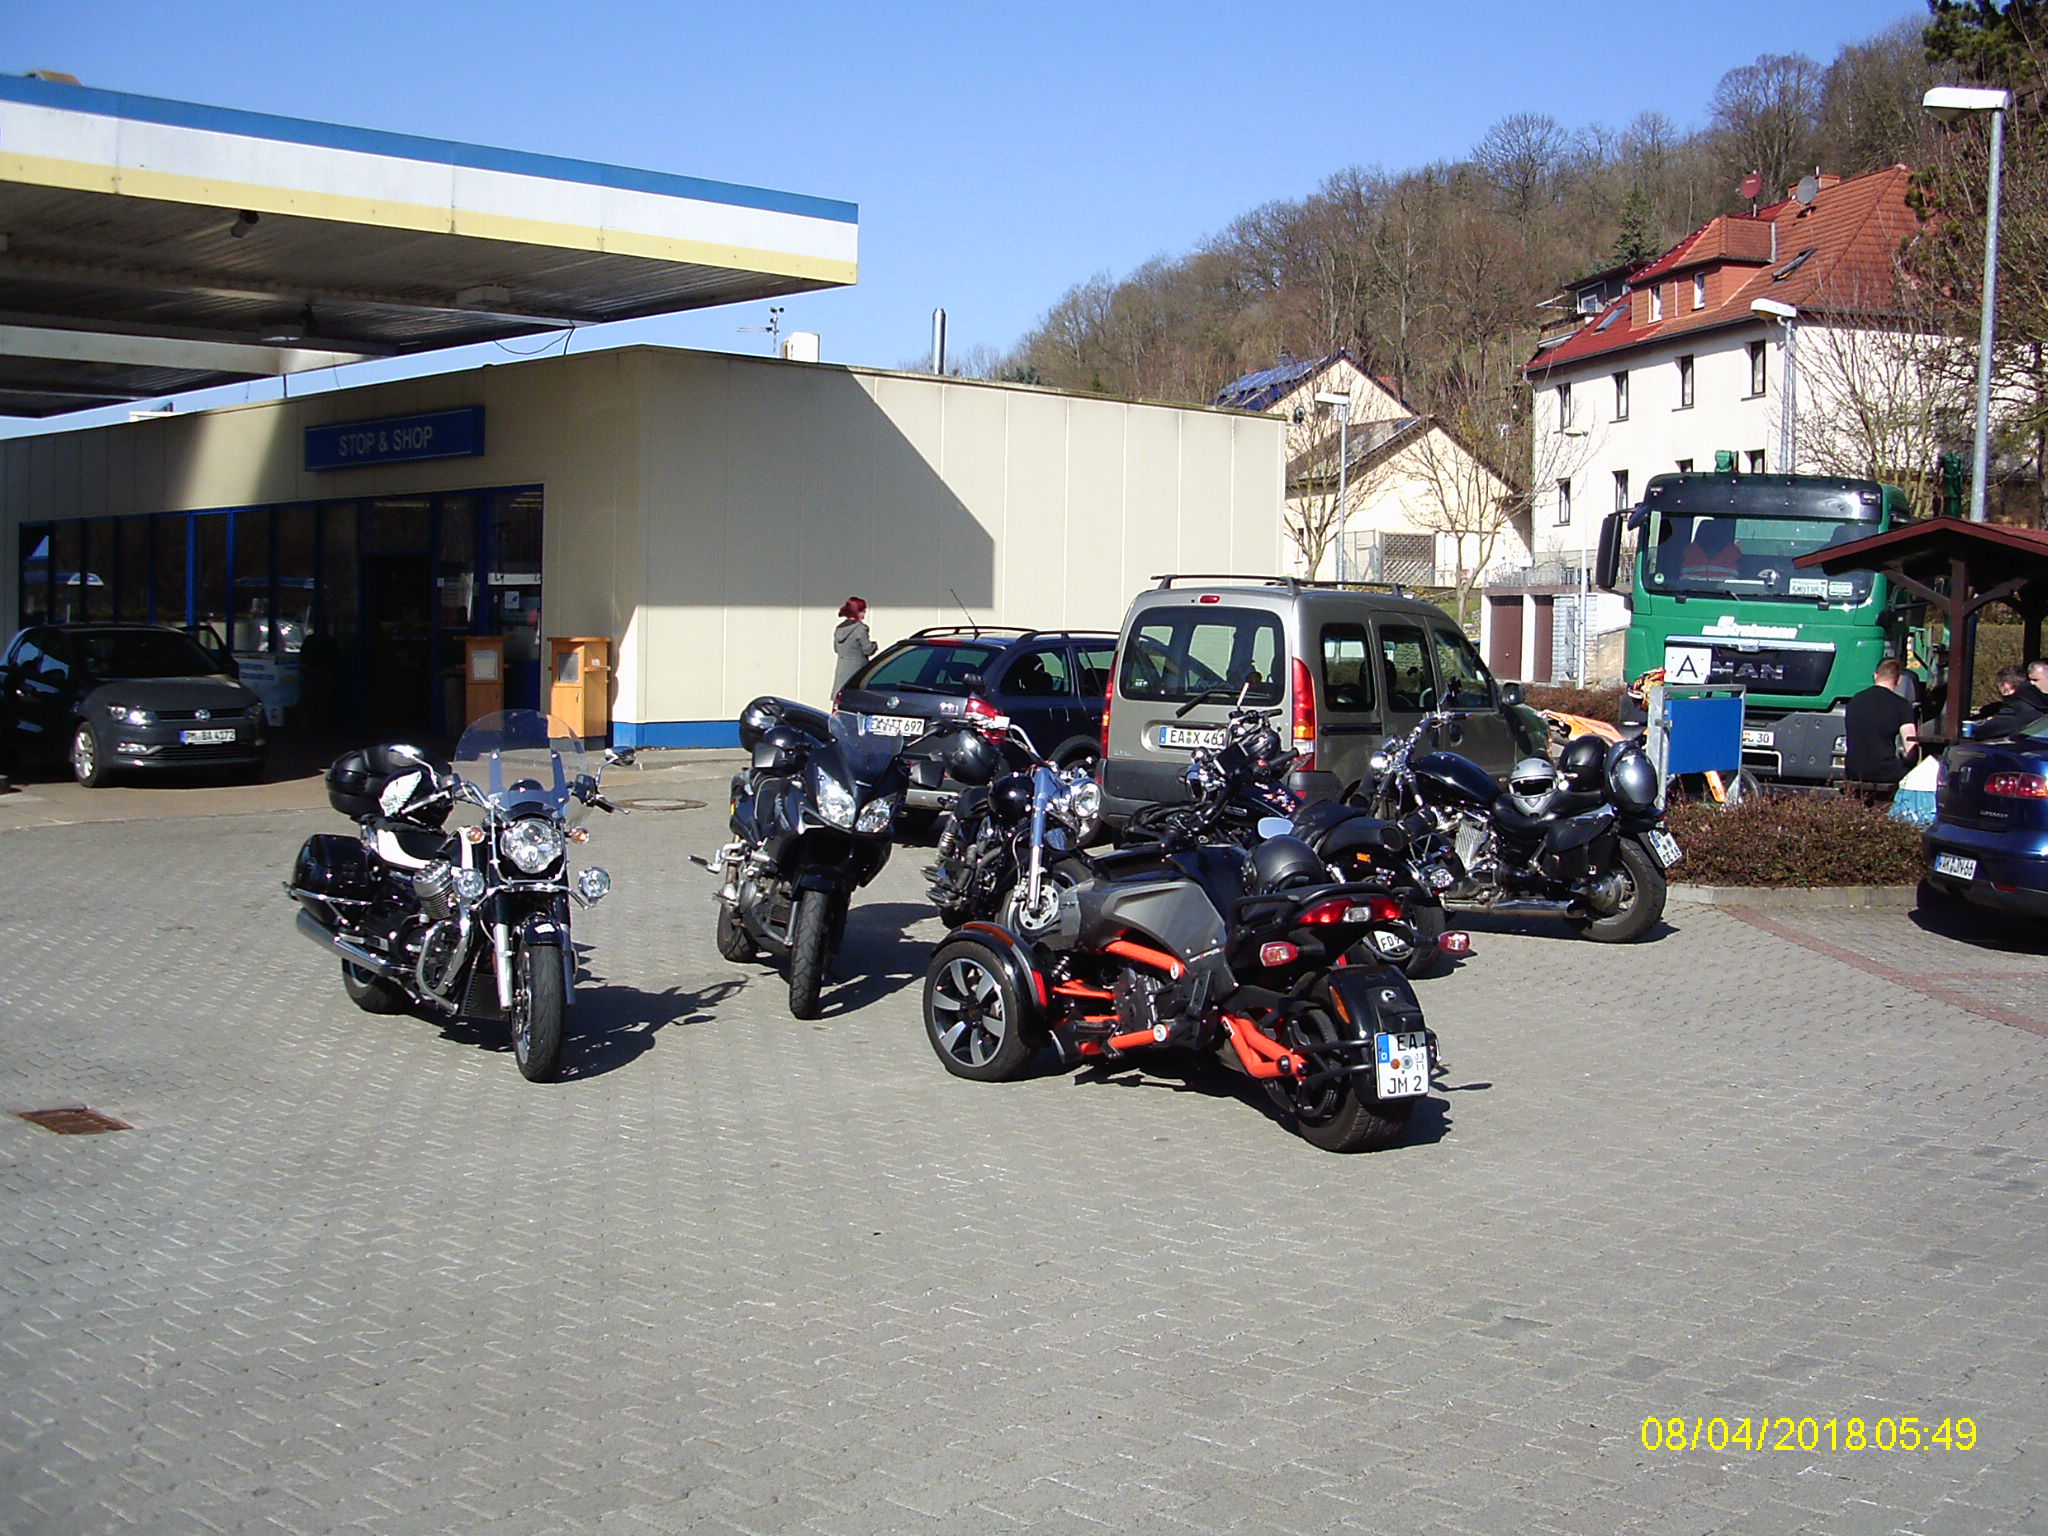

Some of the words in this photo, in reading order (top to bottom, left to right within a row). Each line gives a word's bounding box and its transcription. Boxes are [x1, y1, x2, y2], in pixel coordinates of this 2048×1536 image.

[339, 431, 375, 456] STOP
[378, 431, 388, 452] &
[393, 425, 432, 450] SHOP
[1676, 654, 1698, 678] A
[1711, 660, 1784, 680] MAN
[904, 720, 923, 733] 697
[1170, 730, 1184, 743] EA
[1193, 732, 1201, 745] X
[1756, 733, 1770, 744] 30
[1397, 1033, 1418, 1051] EA
[1387, 1077, 1409, 1095] JM
[1413, 1075, 1422, 1092] 2
